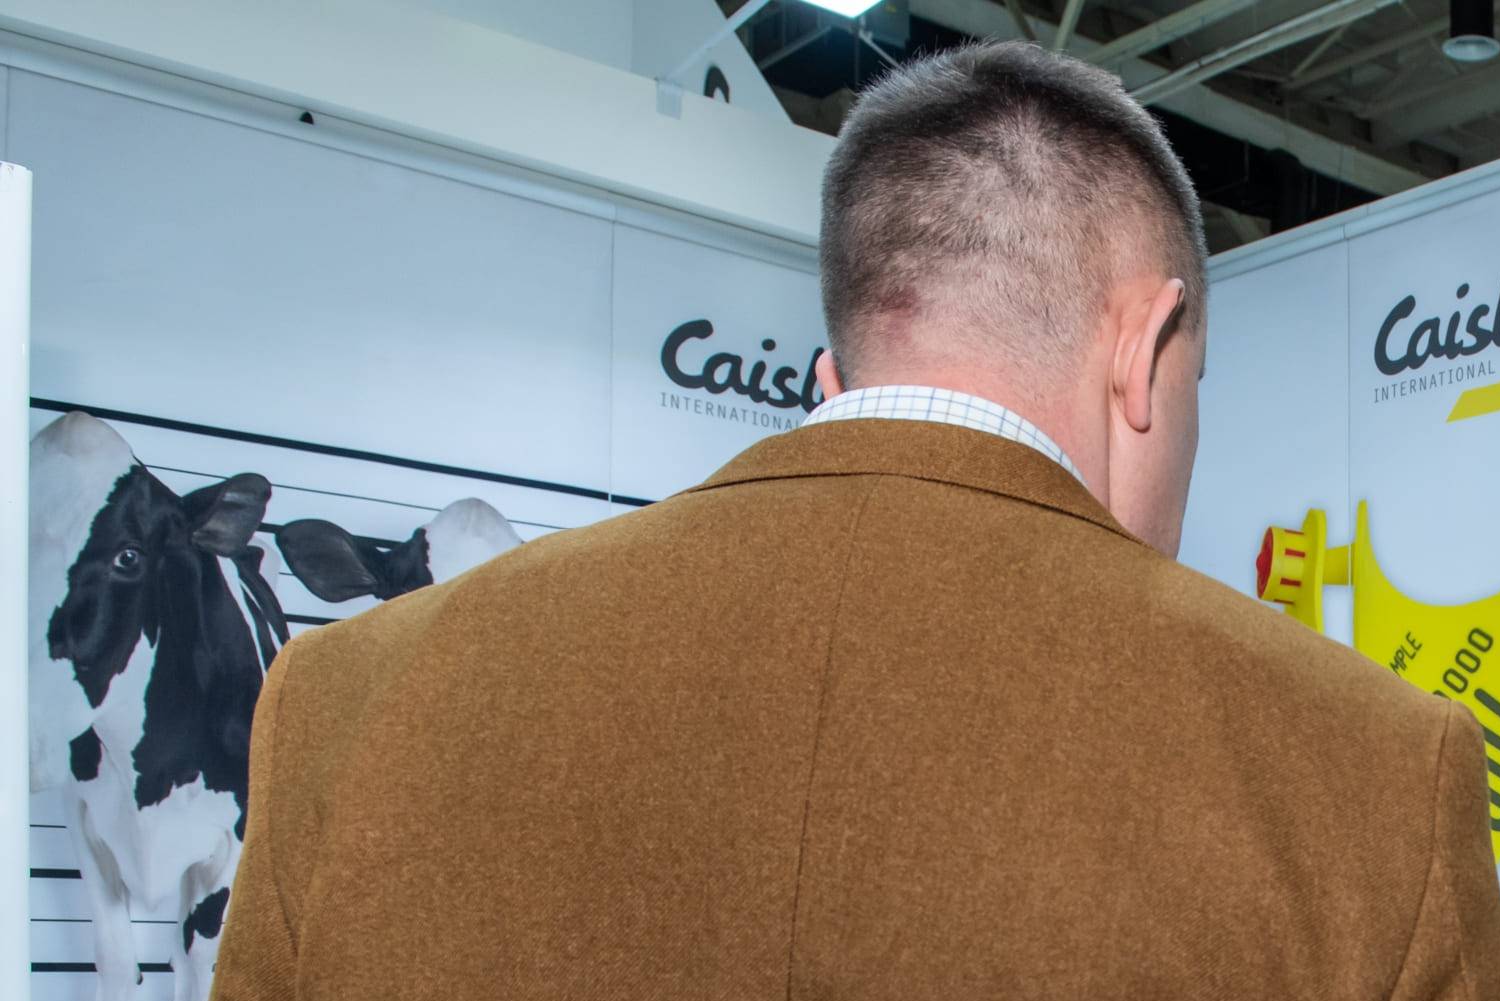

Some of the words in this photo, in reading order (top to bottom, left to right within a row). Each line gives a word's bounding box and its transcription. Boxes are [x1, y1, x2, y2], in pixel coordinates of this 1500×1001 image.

[660, 319, 826, 415] Caisl
[1373, 359, 1496, 404] INTERNATIONAL
[1389, 632, 1423, 676] MPLE
